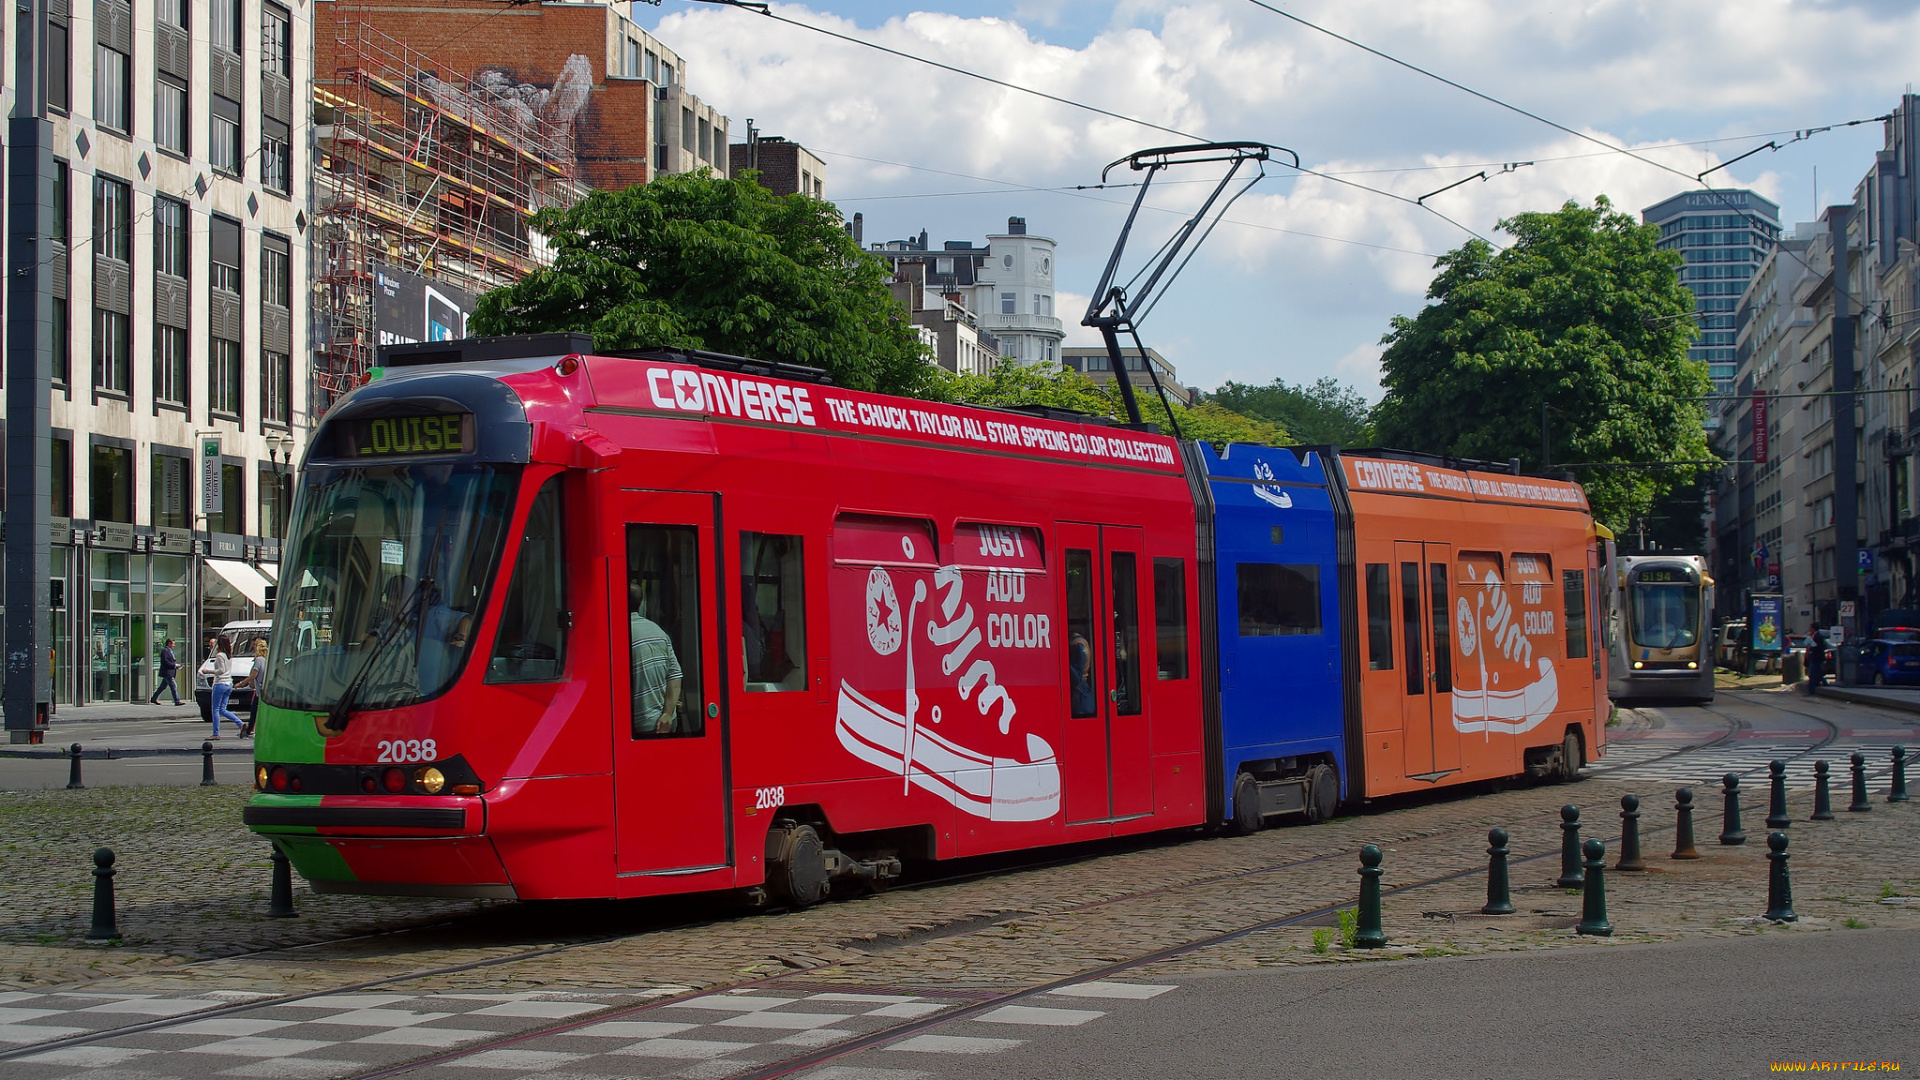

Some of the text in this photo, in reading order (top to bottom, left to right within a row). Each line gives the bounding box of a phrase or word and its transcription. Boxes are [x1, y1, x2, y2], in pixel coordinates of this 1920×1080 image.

[1686, 193, 1749, 205] GENERALI
[384, 276, 400, 289] Windows
[384, 286, 396, 297] Phone
[647, 368, 816, 426] CONVERSE
[360, 415, 463, 454] OUISE
[825, 398, 1175, 465] THE CHUCK TAYLOR ALL STAR SPRING COLOR COLLECTION
[1756, 401, 1766, 458] Thon Hotels
[1354, 461, 1425, 491] CONVERSE
[1426, 471, 1443, 488] THE
[1441, 474, 1466, 492] CHUCK
[1489, 481, 1504, 496] ALL
[1501, 482, 1520, 498] STAR
[1541, 486, 1562, 502] COLOR
[219, 541, 236, 552] FURLA
[977, 524, 1025, 557] JUST
[1517, 556, 1540, 574] JUST
[868, 569, 897, 608] CONVERSE
[986, 566, 1026, 603] ADD
[1523, 580, 1542, 604] ADD
[1841, 604, 1853, 613] 27
[987, 613, 1051, 649] COLOR
[1524, 610, 1554, 635] COLOR
[377, 738, 437, 763] 2038
[755, 786, 785, 809] 2038
